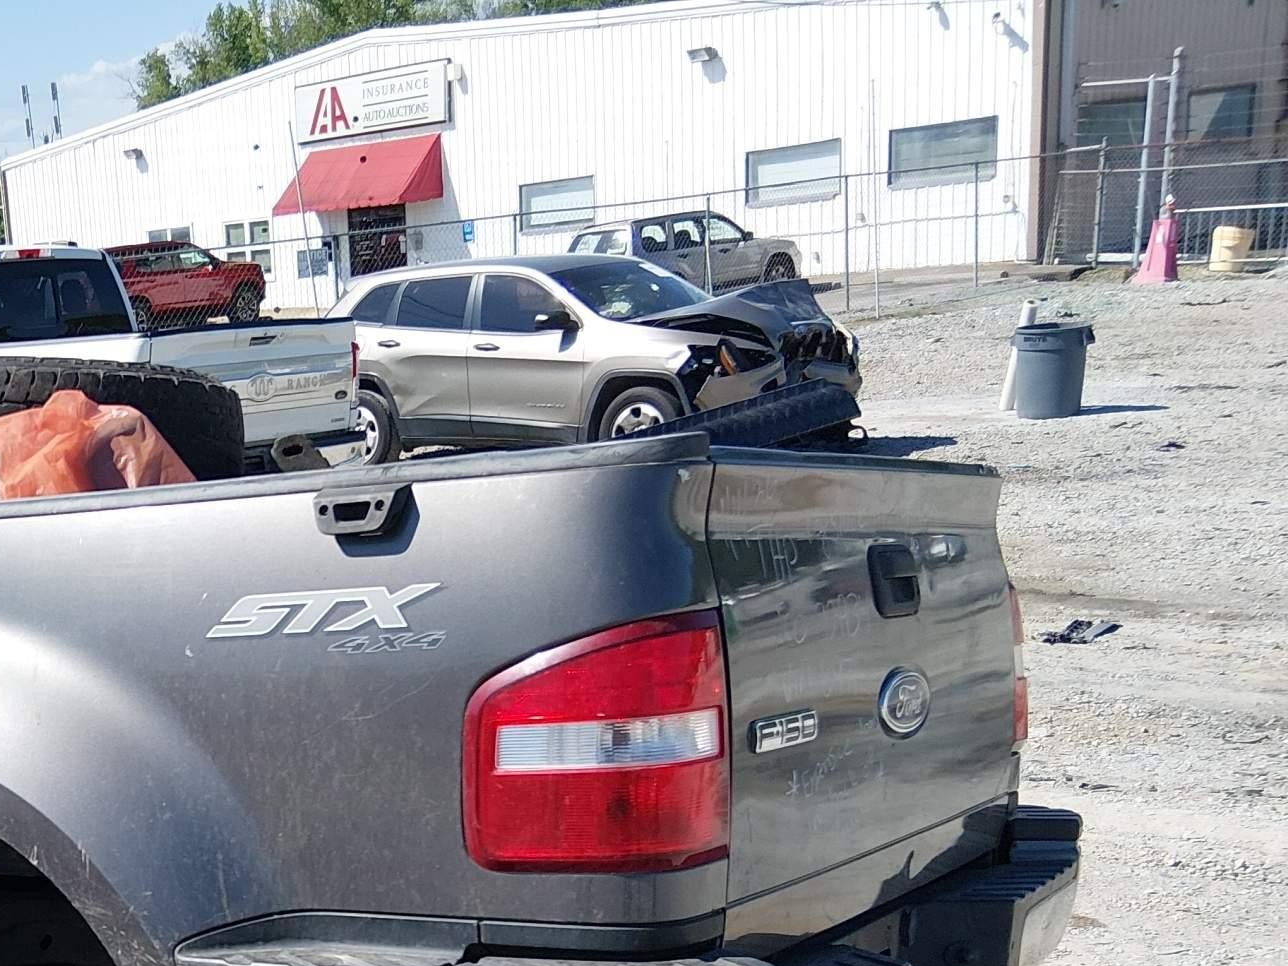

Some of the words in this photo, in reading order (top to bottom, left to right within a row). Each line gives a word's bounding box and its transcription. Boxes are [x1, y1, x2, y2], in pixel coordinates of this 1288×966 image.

[362, 77, 429, 99] INSURANCE
[363, 109, 386, 122] AUTO
[387, 102, 429, 119] AUCTIONS
[206, 582, 442, 638] STX
[895, 684, 924, 719] Ford
